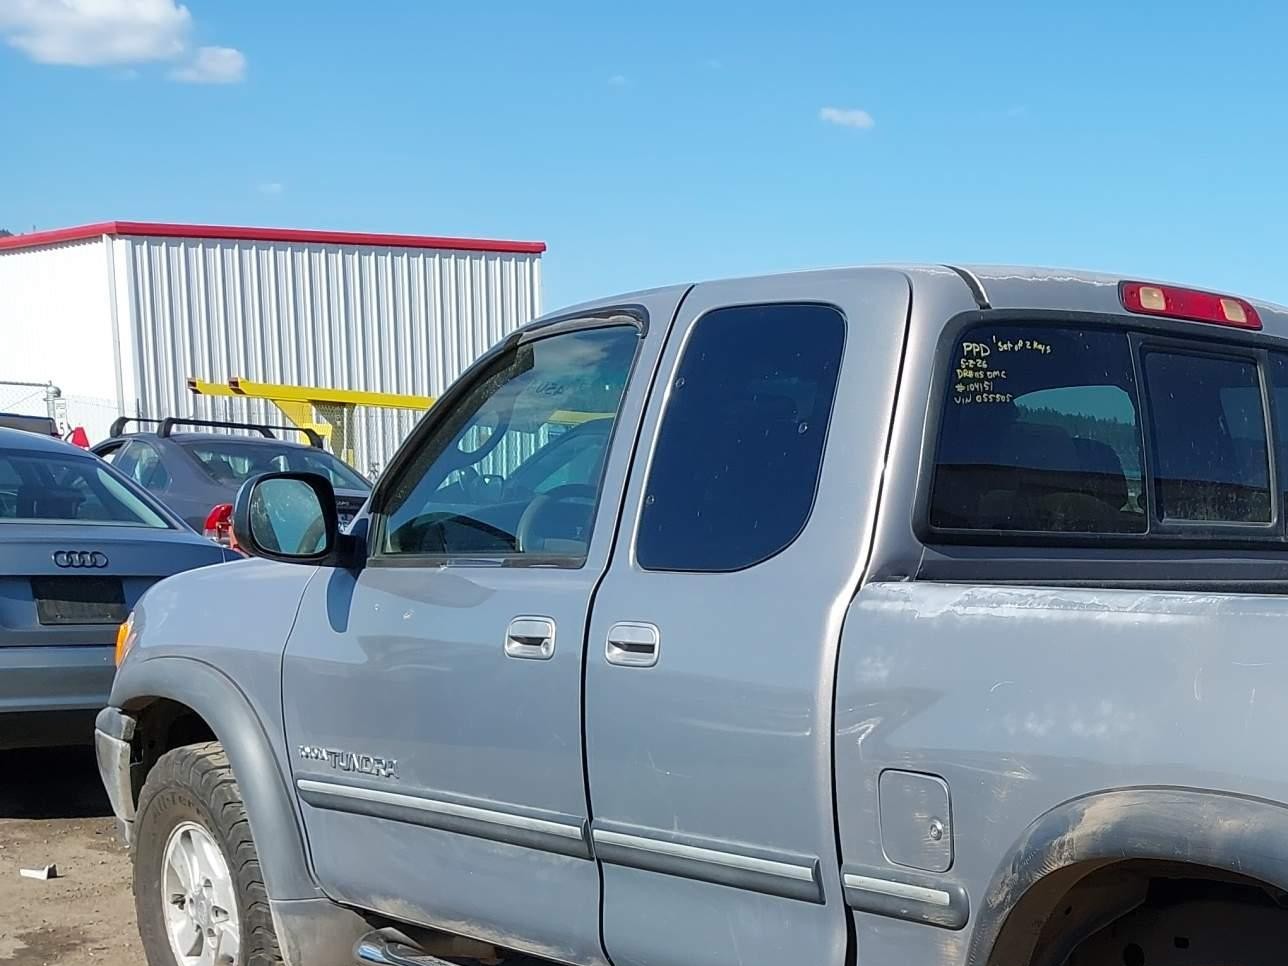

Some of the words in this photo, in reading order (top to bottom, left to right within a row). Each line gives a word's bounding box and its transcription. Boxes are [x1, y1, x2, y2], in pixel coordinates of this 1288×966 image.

[962, 342, 991, 356] PPD
[1025, 341, 1032, 349] 2
[327, 749, 401, 780] TUNDRA
